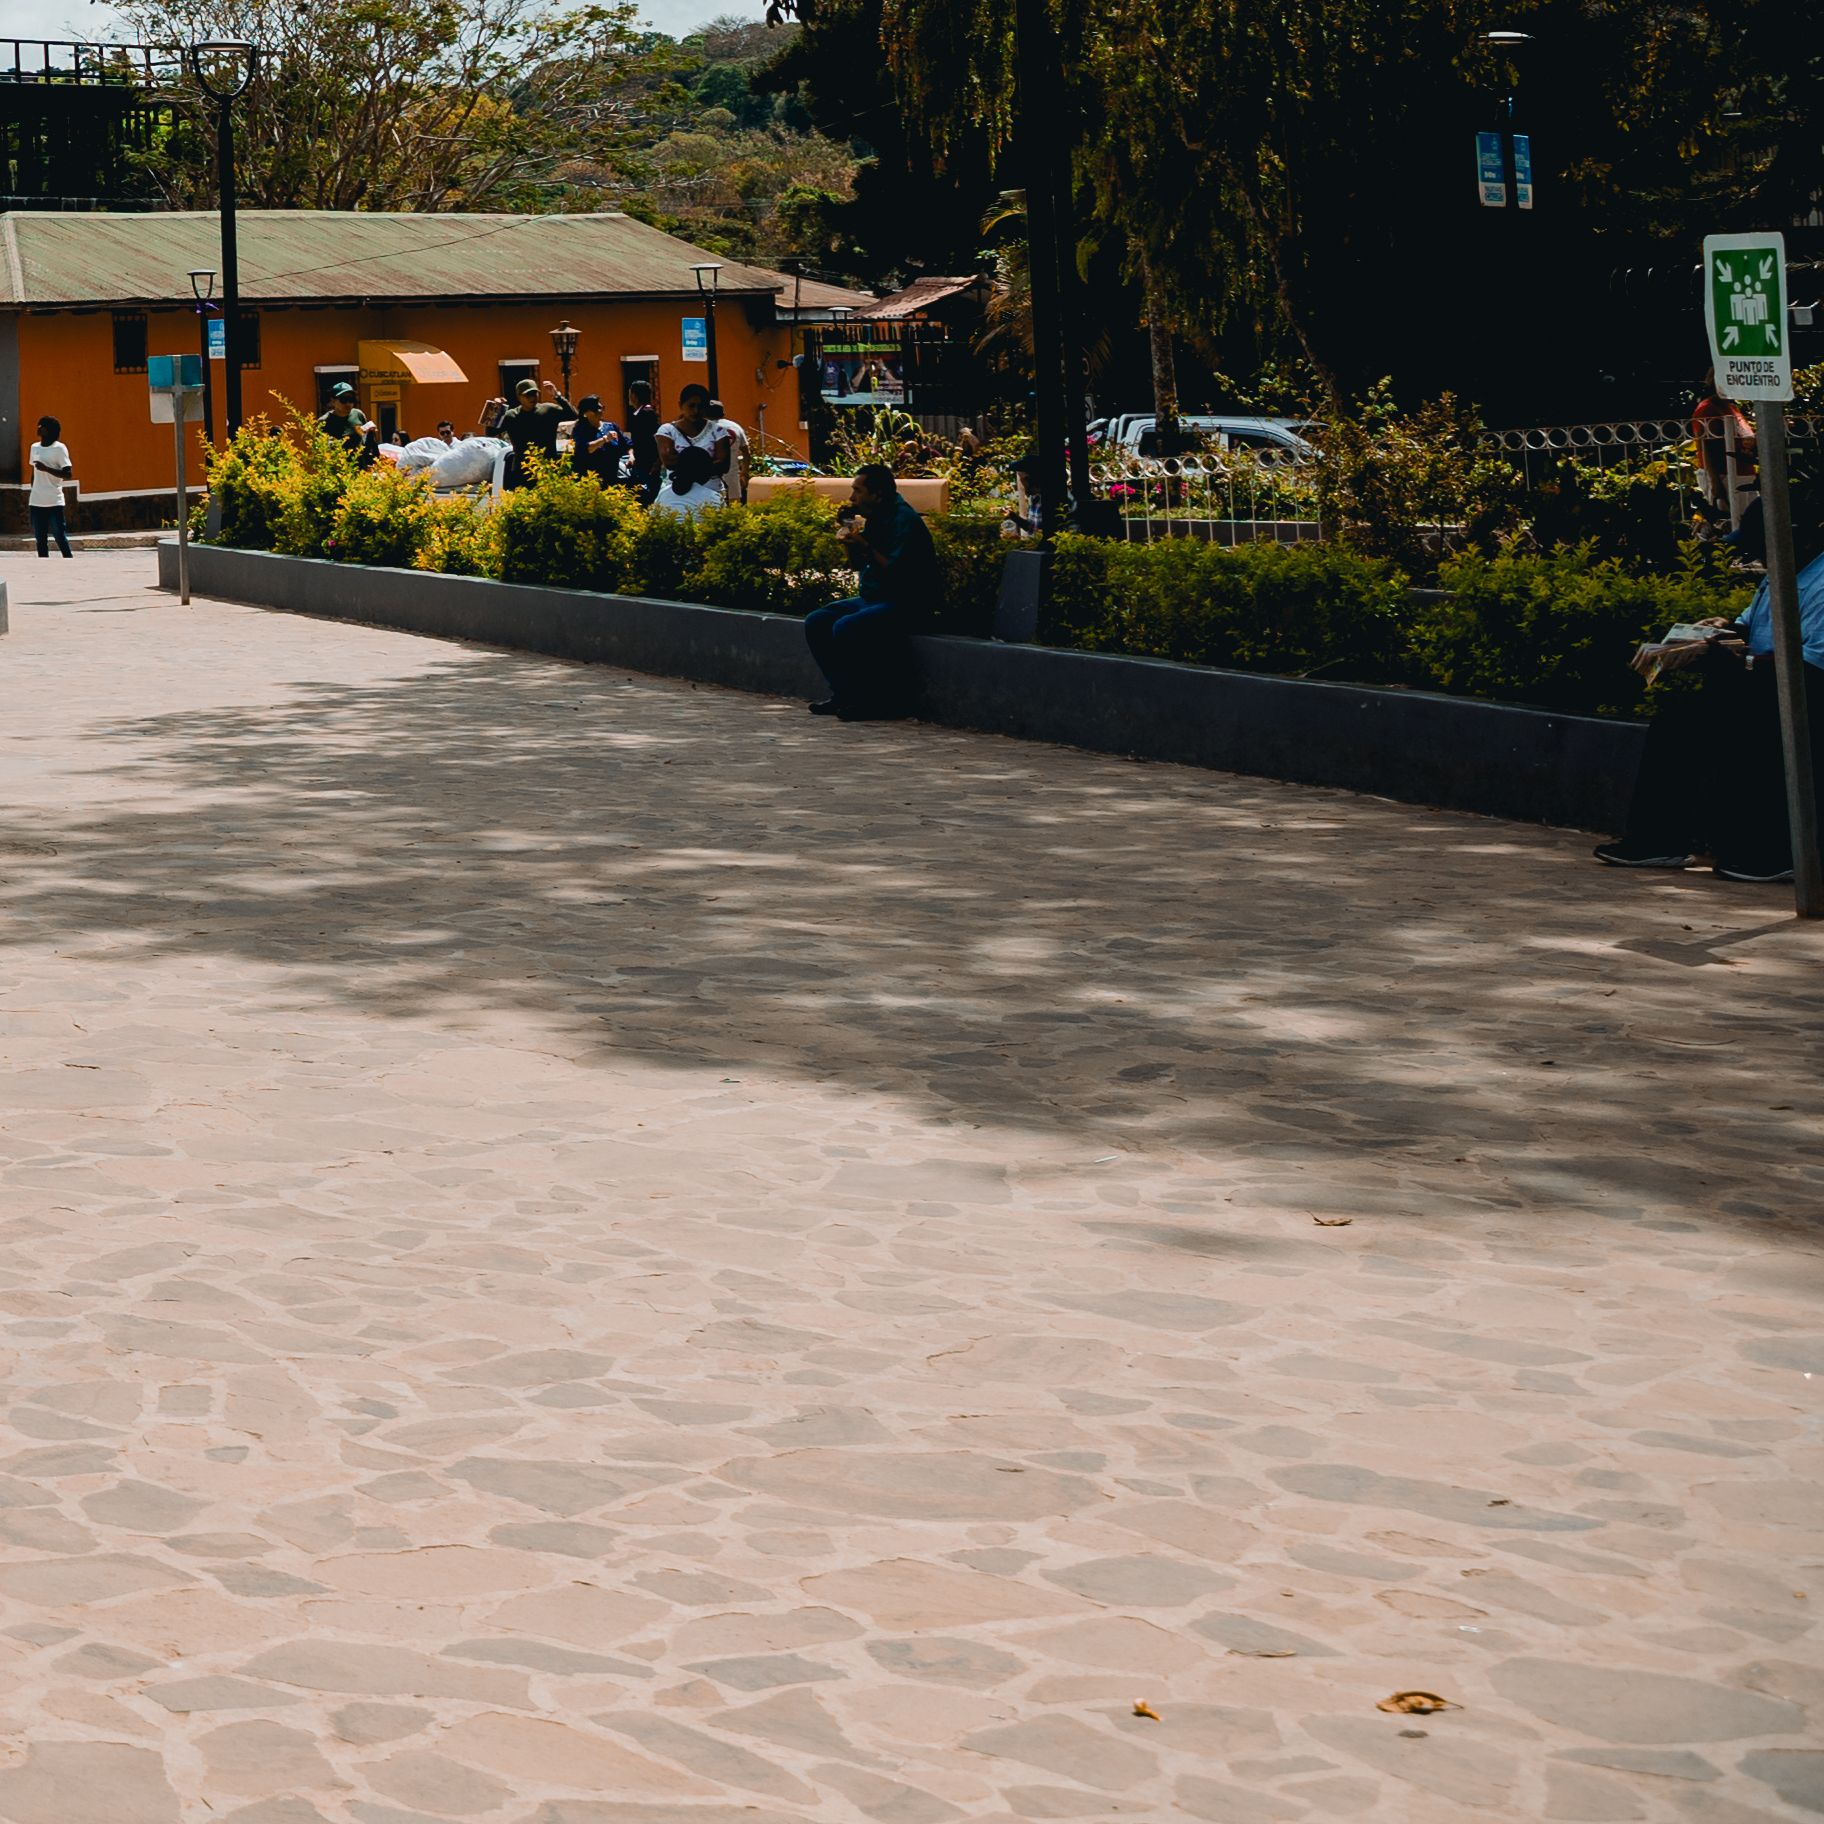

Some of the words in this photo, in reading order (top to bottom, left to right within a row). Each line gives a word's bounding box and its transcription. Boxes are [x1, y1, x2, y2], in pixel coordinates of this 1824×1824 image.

[1729, 361, 1762, 372] PUNTO
[1763, 361, 1774, 372] DE
[1726, 374, 1780, 386] ENCUENTRO
